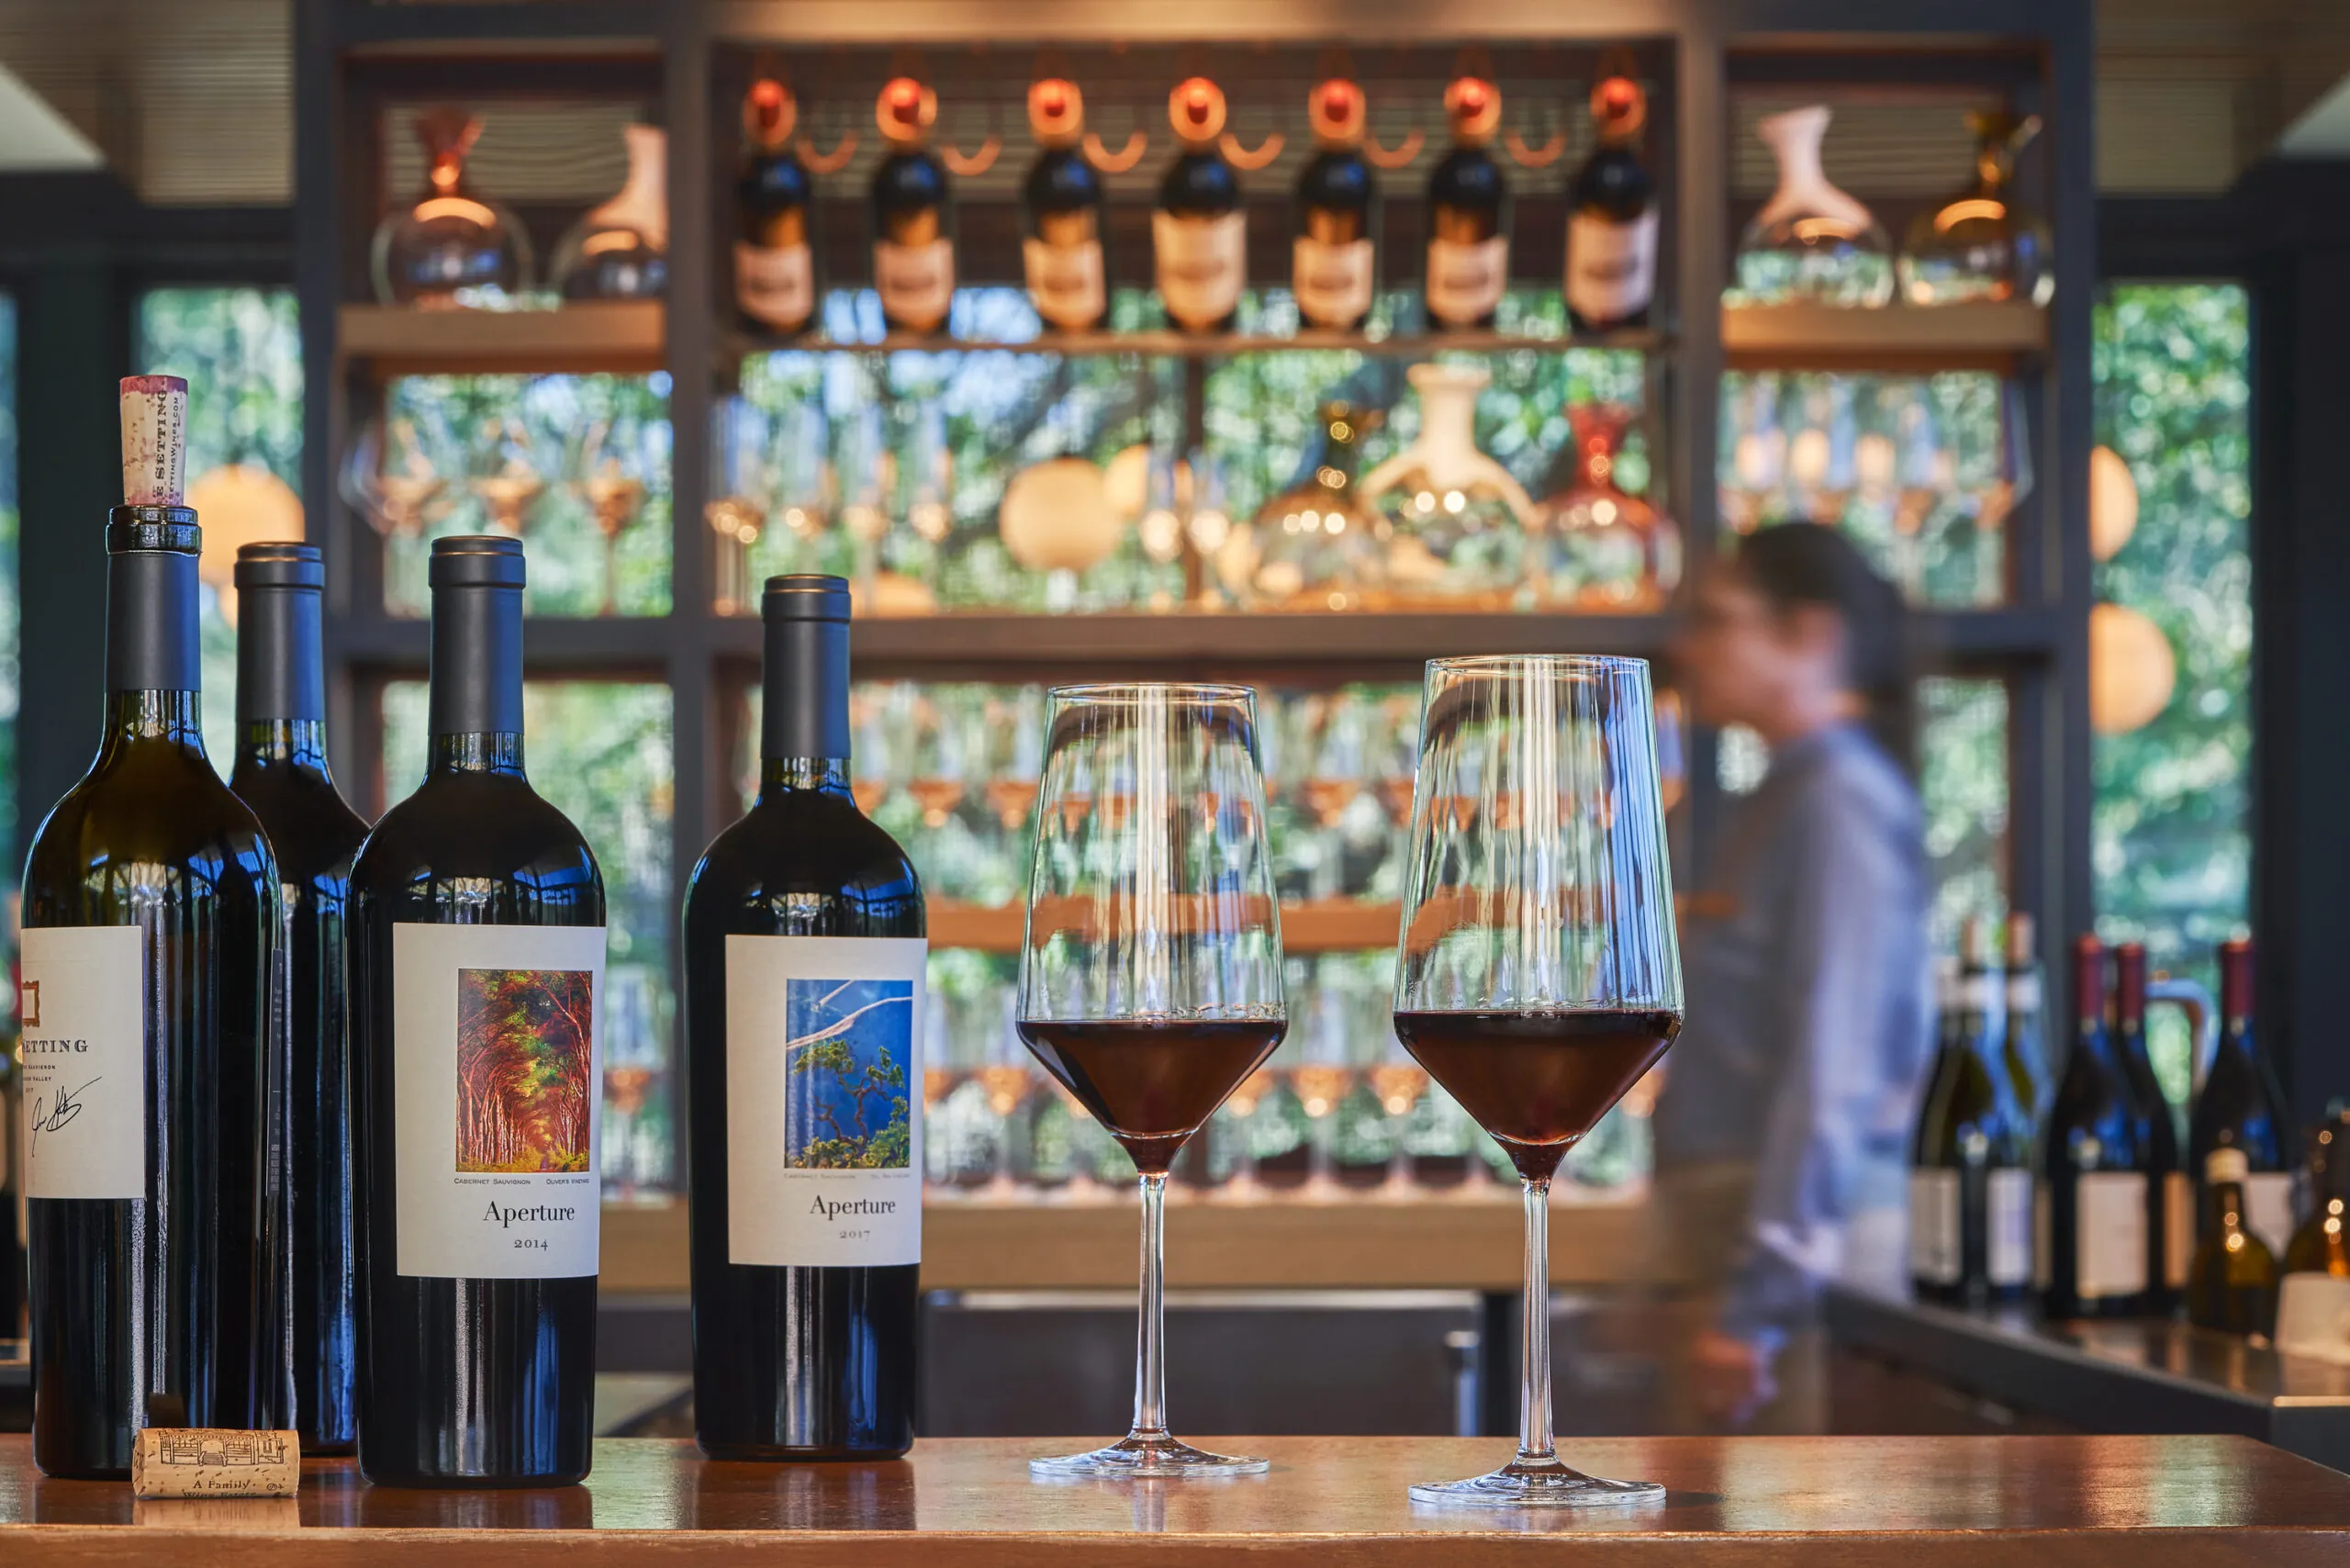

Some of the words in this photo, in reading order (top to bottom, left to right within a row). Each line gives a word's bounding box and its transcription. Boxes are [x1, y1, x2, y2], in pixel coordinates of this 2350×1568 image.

[155, 389, 168, 479] SETTING
[483, 1200, 576, 1228] Aperture
[809, 1194, 896, 1221] Aperture
[514, 1238, 549, 1252] 2014
[839, 1230, 870, 1242] 2017
[193, 1480, 202, 1489] A
[208, 1480, 252, 1490] Family
